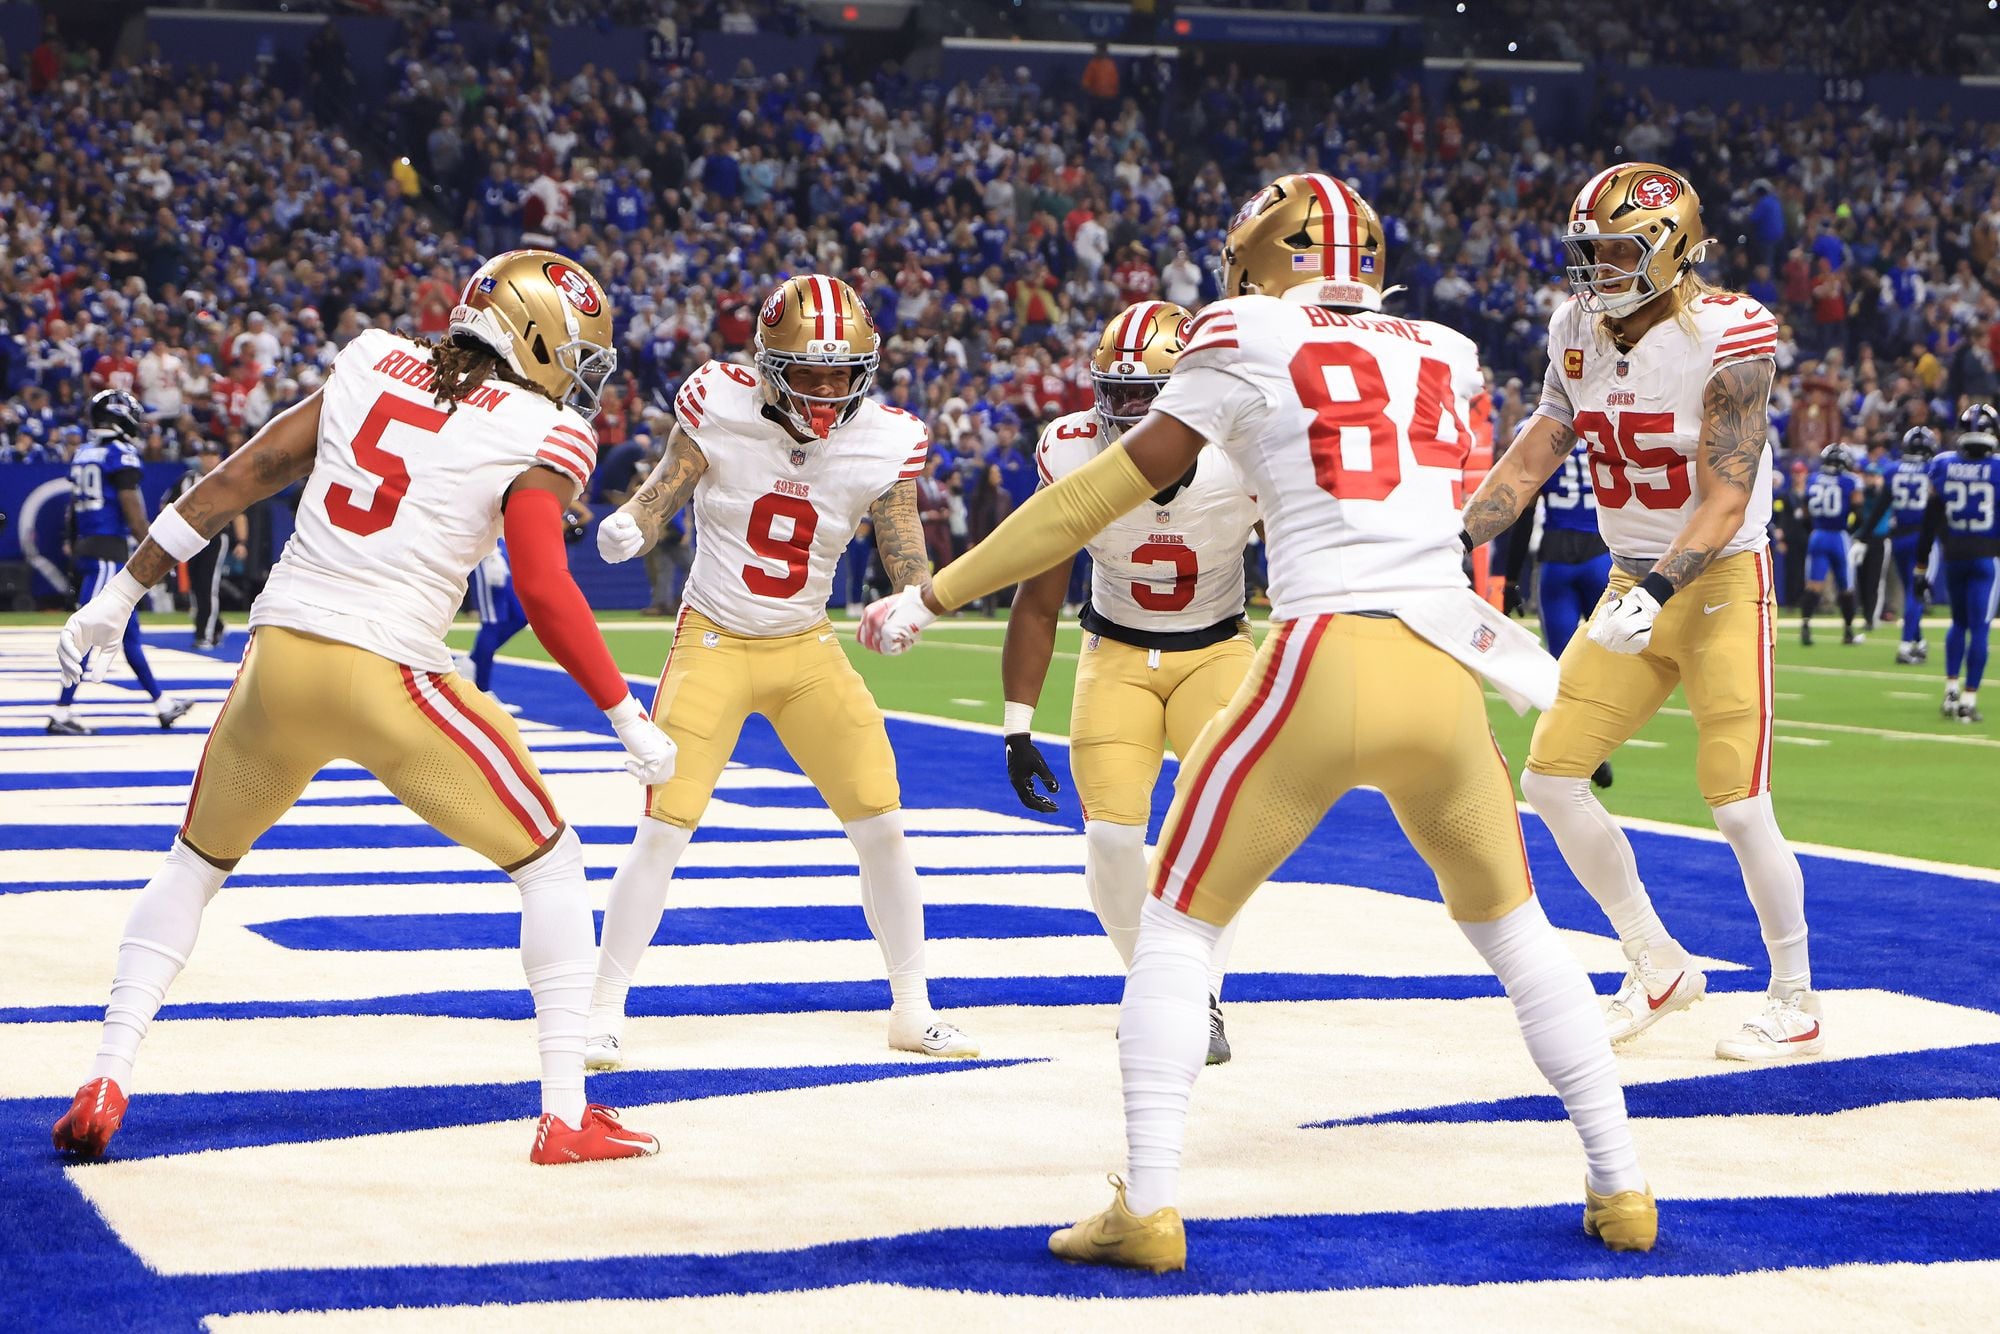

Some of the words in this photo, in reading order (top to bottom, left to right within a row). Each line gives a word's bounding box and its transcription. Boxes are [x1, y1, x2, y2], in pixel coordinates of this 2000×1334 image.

[373, 350, 510, 412] ROBON
[1565, 351, 1581, 371] C
[1606, 392, 1635, 406] 49ERS
[1056, 422, 1098, 440] 3
[1288, 341, 1473, 511] 84
[323, 390, 451, 537] 5
[1572, 411, 1691, 509] 85
[773, 480, 810, 498] 49ERS
[1808, 484, 1842, 517] 20
[1891, 473, 1929, 510] 53
[1943, 481, 1995, 531] 23
[741, 492, 819, 599] 9
[1148, 533, 1184, 544] 49ERS
[1131, 543, 1198, 612] 3
